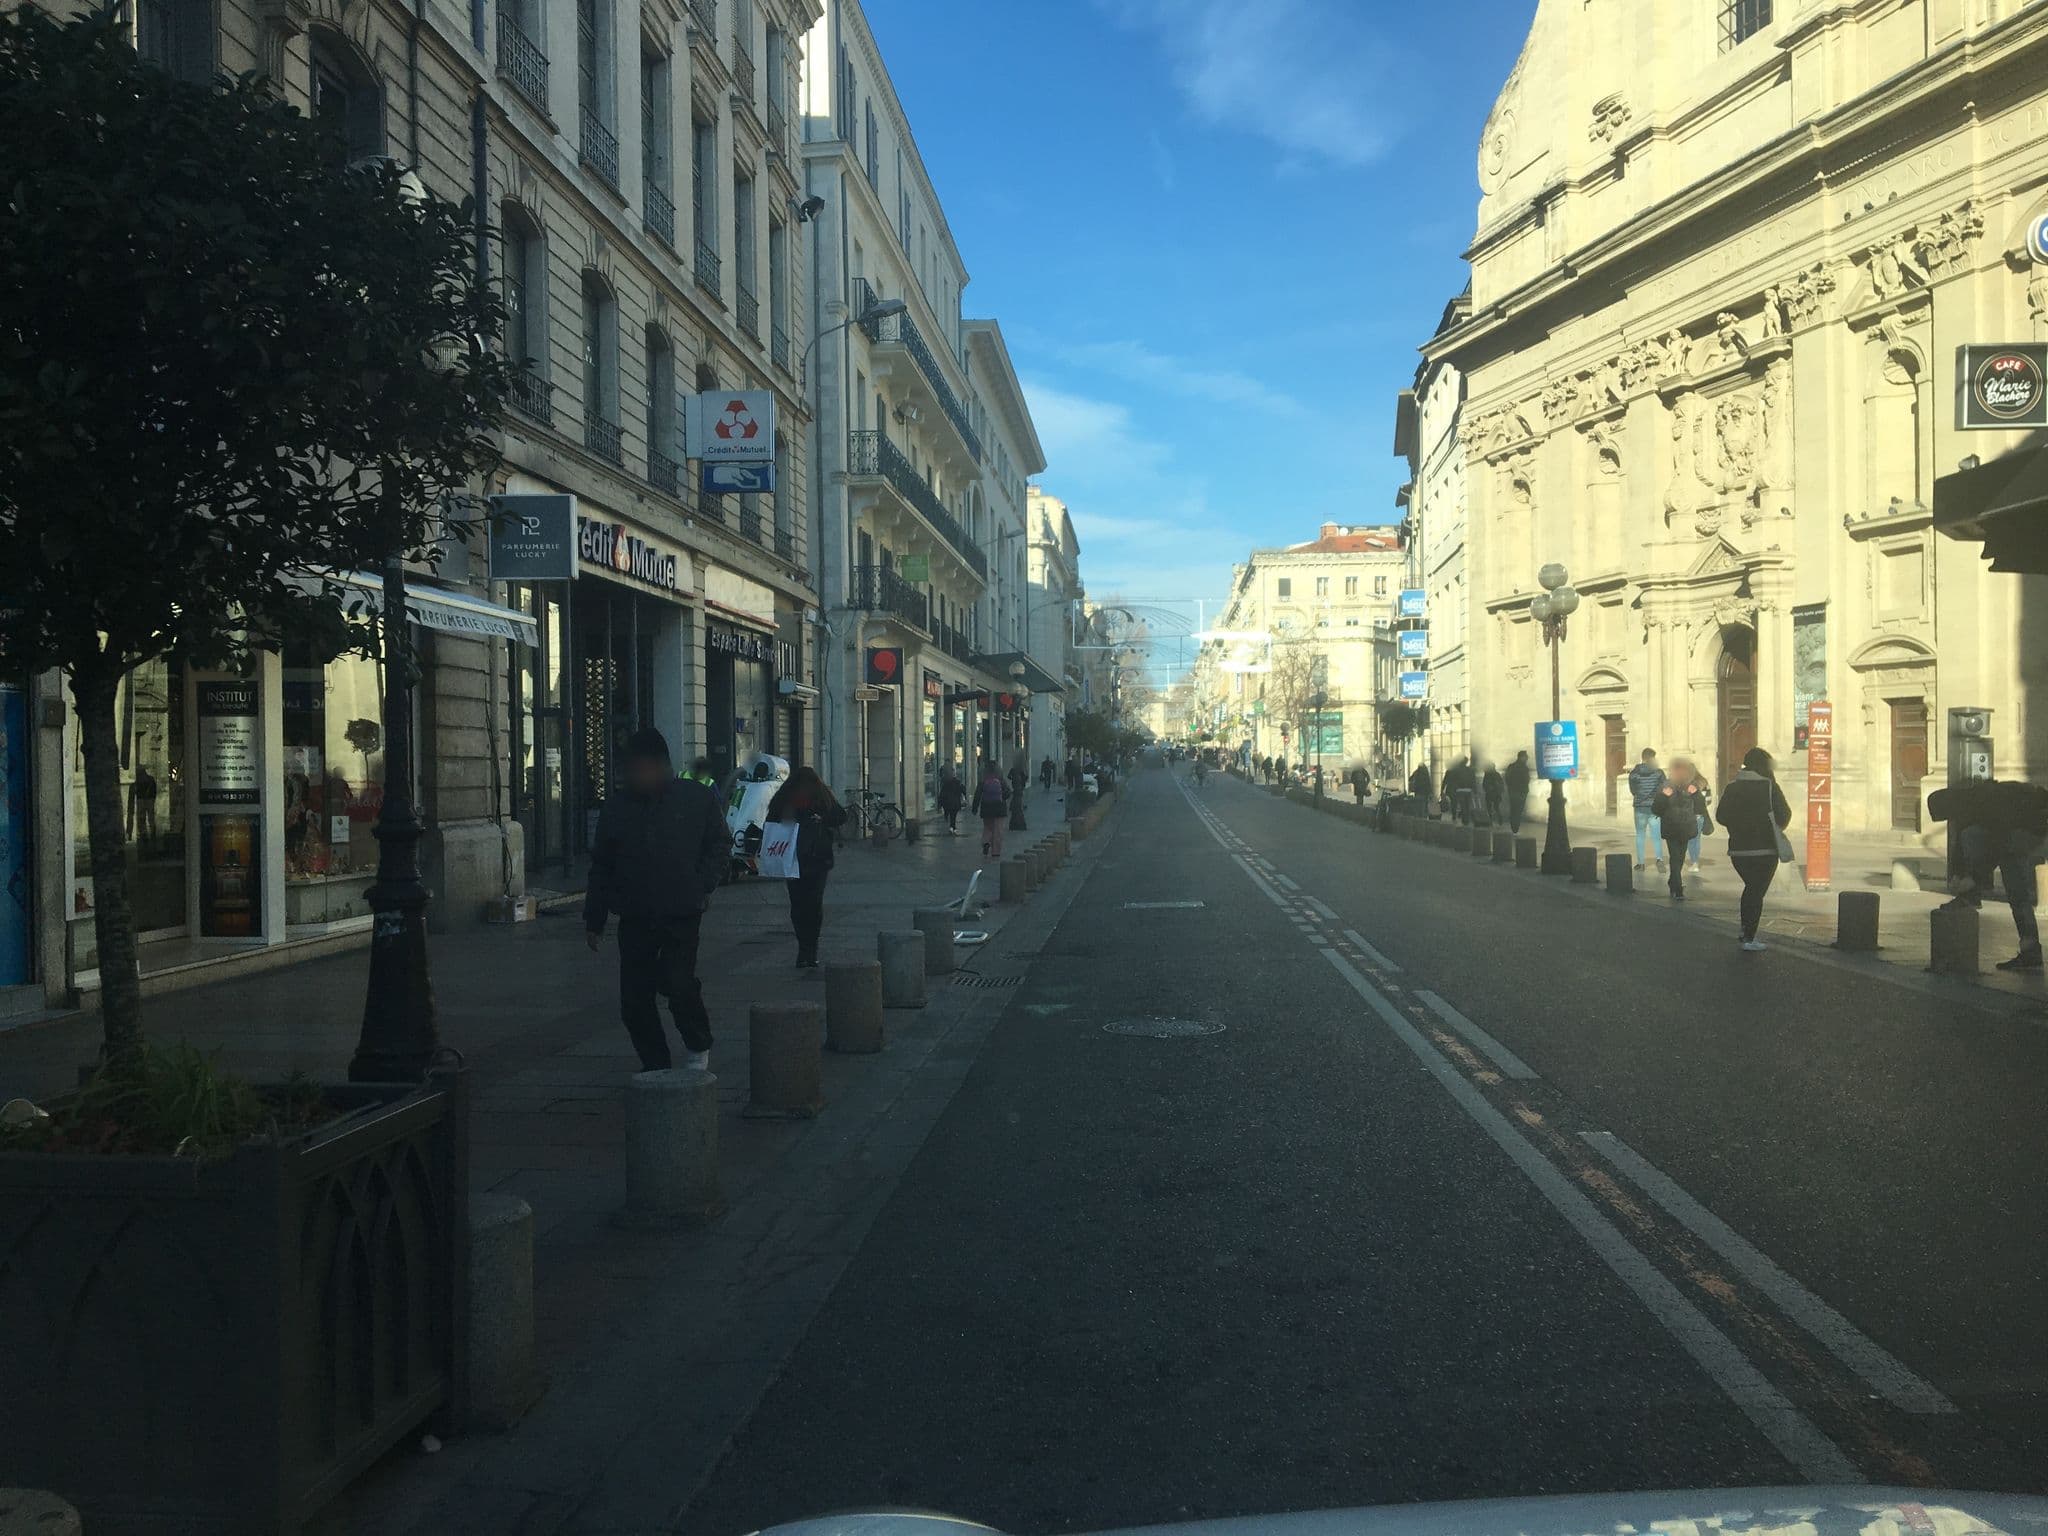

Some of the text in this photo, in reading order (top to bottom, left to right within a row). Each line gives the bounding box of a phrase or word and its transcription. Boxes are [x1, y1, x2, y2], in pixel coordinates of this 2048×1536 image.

[1995, 359, 2022, 371] CAFÉ
[1984, 376, 2032, 393] Marie
[707, 445, 767, 454] Crédit Mutuel
[501, 543, 561, 551] PARFUMERIE
[578, 518, 614, 567] édit
[514, 551, 547, 559] LUCKY
[1402, 598, 1425, 610] bleu
[421, 610, 510, 636] ARFUMERIE LUCKY
[1402, 640, 1425, 651] bleu
[1403, 681, 1426, 692] bleu
[206, 690, 254, 703] INSTITUT
